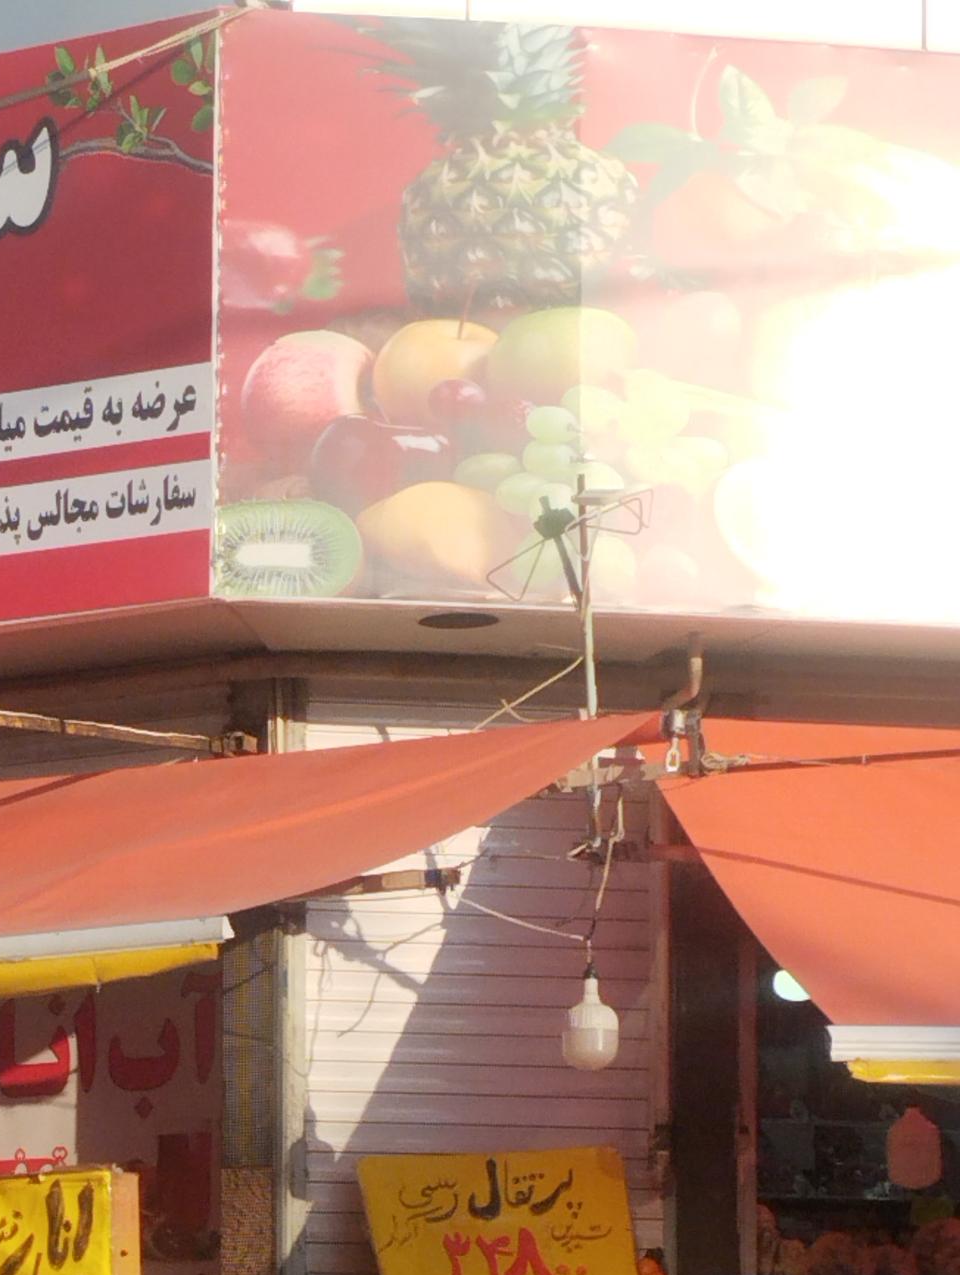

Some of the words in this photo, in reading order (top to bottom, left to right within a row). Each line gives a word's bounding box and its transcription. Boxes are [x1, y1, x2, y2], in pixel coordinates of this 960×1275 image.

[33, 386, 94, 442] قیمت
[101, 394, 124, 436] به
[131, 381, 197, 432] عرضه
[26, 488, 99, 541] مجالس
[104, 474, 197, 526] سفارشات
[108, 972, 224, 1120] آب
[468, 1157, 583, 1221] پرتقال
